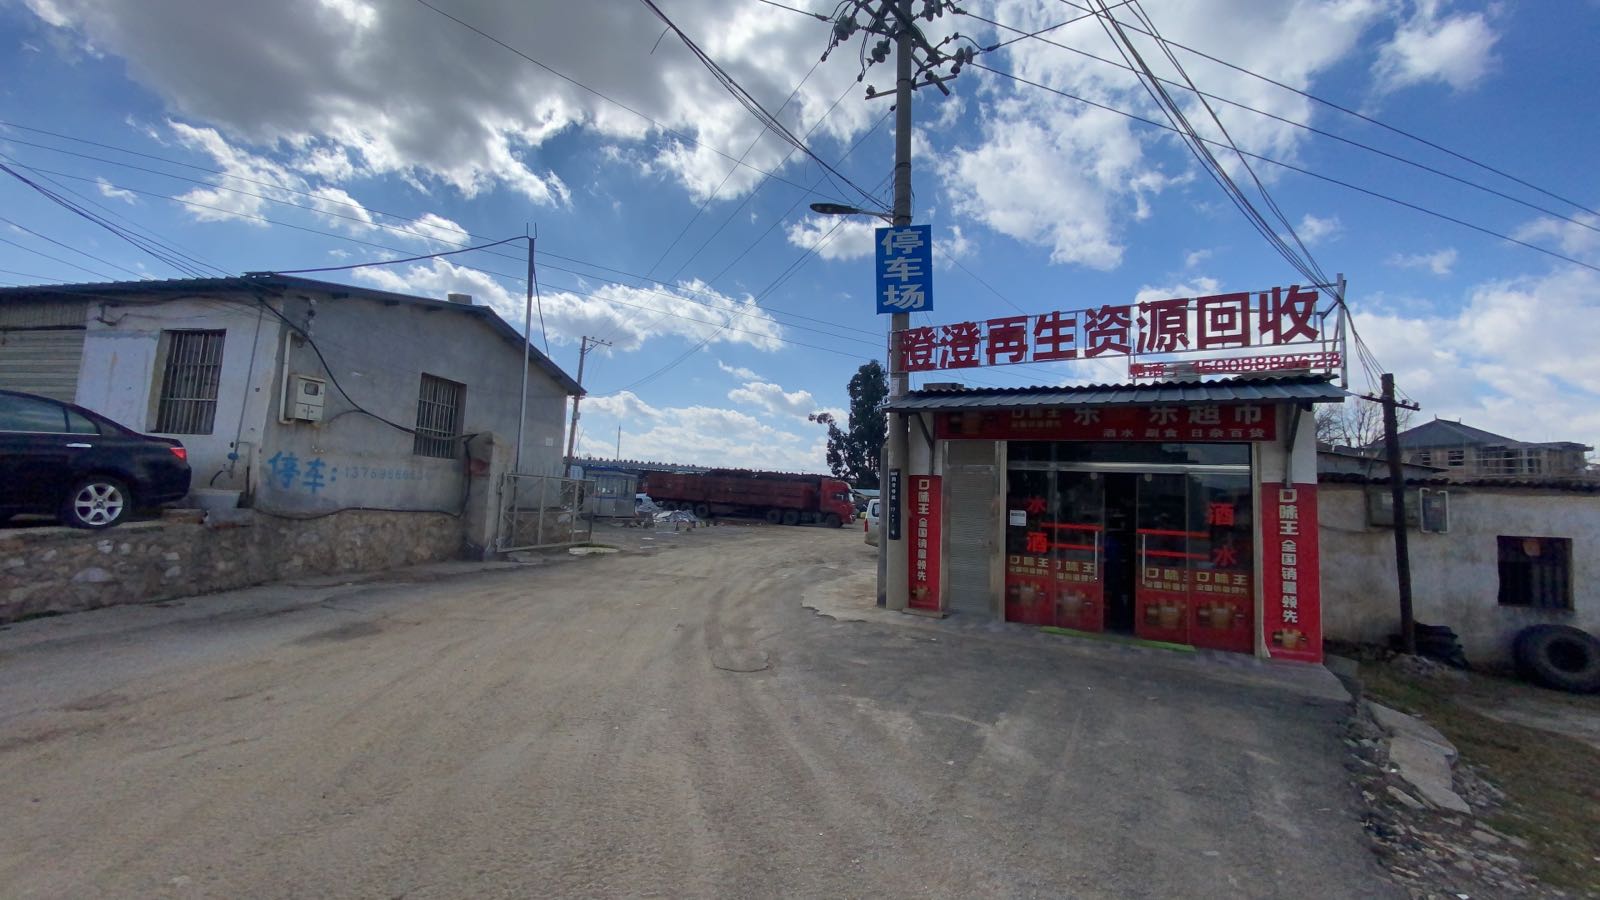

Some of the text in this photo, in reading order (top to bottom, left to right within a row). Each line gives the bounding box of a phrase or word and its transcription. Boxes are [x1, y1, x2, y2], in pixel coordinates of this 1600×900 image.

[880, 228, 926, 310] 停车场
[1278, 488, 1299, 624] 口味王 全国销量领先
